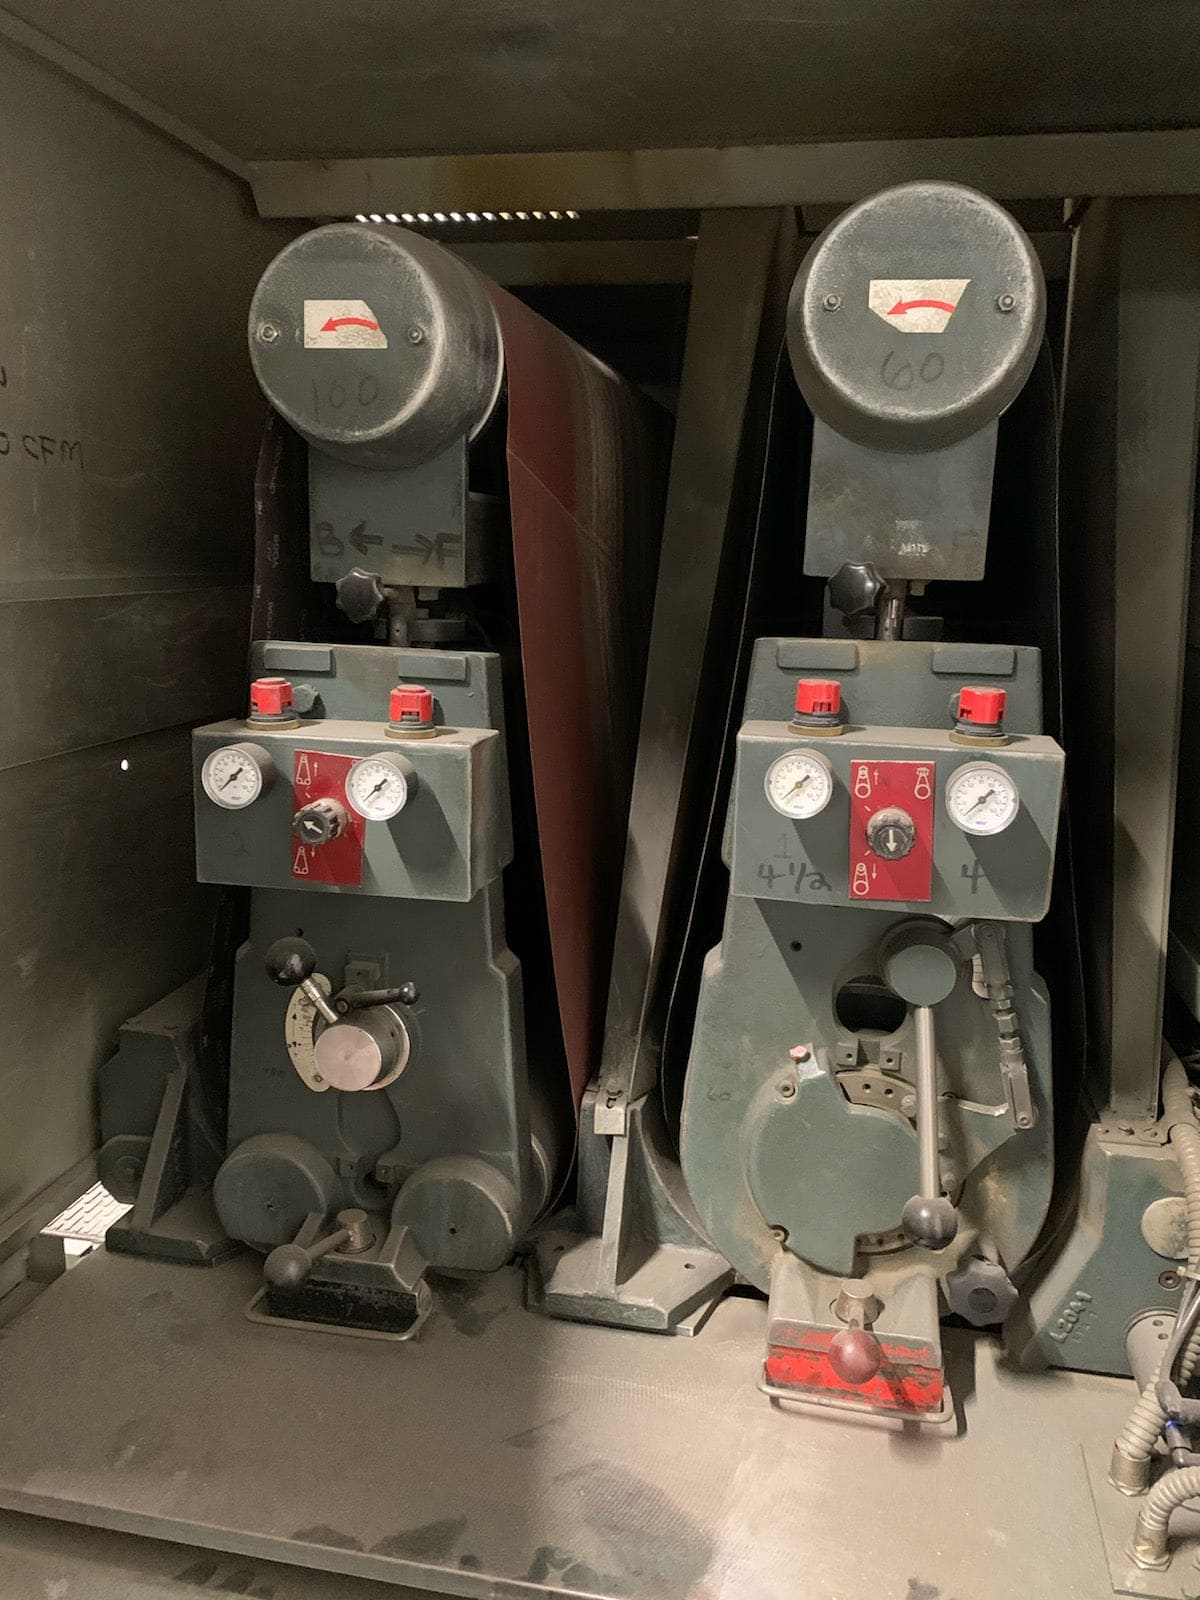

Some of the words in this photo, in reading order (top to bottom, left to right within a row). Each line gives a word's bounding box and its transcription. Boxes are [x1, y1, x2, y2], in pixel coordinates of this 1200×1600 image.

[880, 350, 944, 391] 60
[22, 434, 84, 469] CFM
[315, 521, 345, 558] B
[436, 532, 463, 569] F
[961, 859, 985, 895] 4
